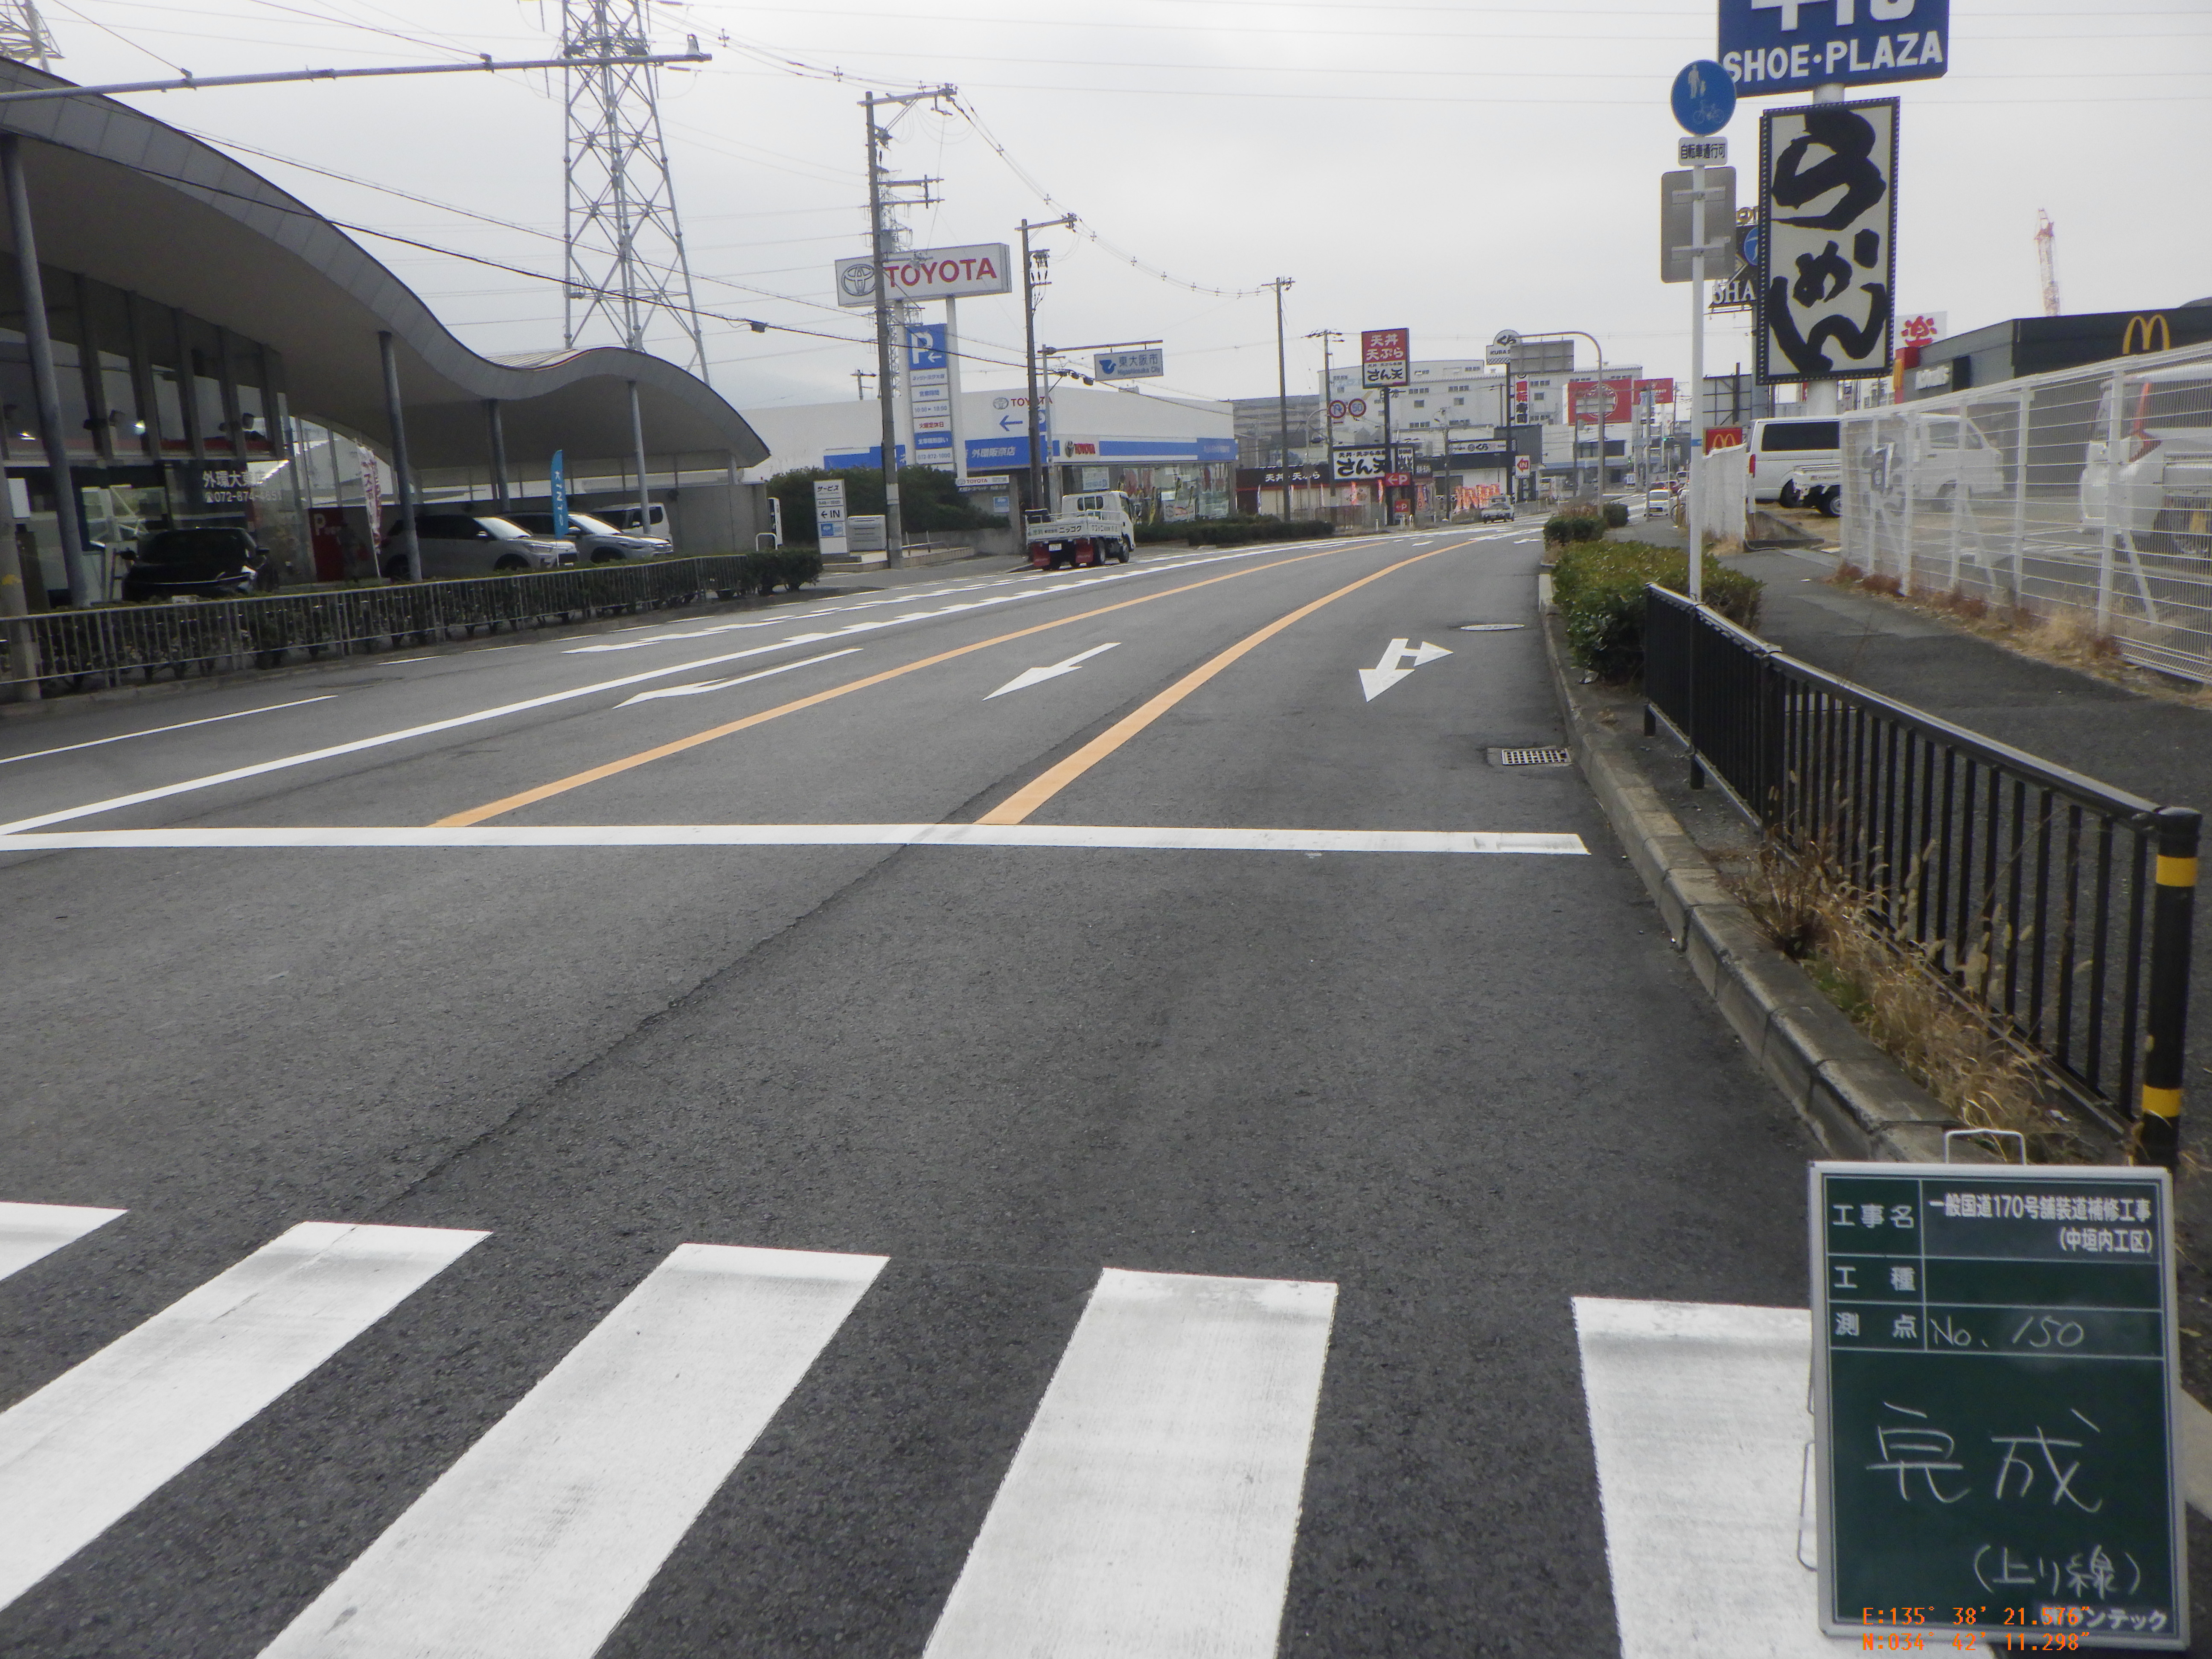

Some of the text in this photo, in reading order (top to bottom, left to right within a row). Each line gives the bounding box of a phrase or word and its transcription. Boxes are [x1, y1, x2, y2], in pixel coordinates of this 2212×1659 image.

[1680, 143, 1726, 160] 自転車通行可
[884, 257, 997, 288] TOYOTA
[911, 331, 933, 364] P
[1371, 333, 1399, 347] 天丼
[1118, 353, 1158, 367] 東大阪市
[1366, 347, 1403, 361] 天ぷら
[1367, 368, 1403, 381] さん天
[1399, 474, 1408, 485] P
[830, 510, 840, 518] IN
[1833, 1203, 1914, 1229] 工事名
[2012, 1316, 2084, 1347] 150
[1866, 1401, 2103, 1513] 完成
